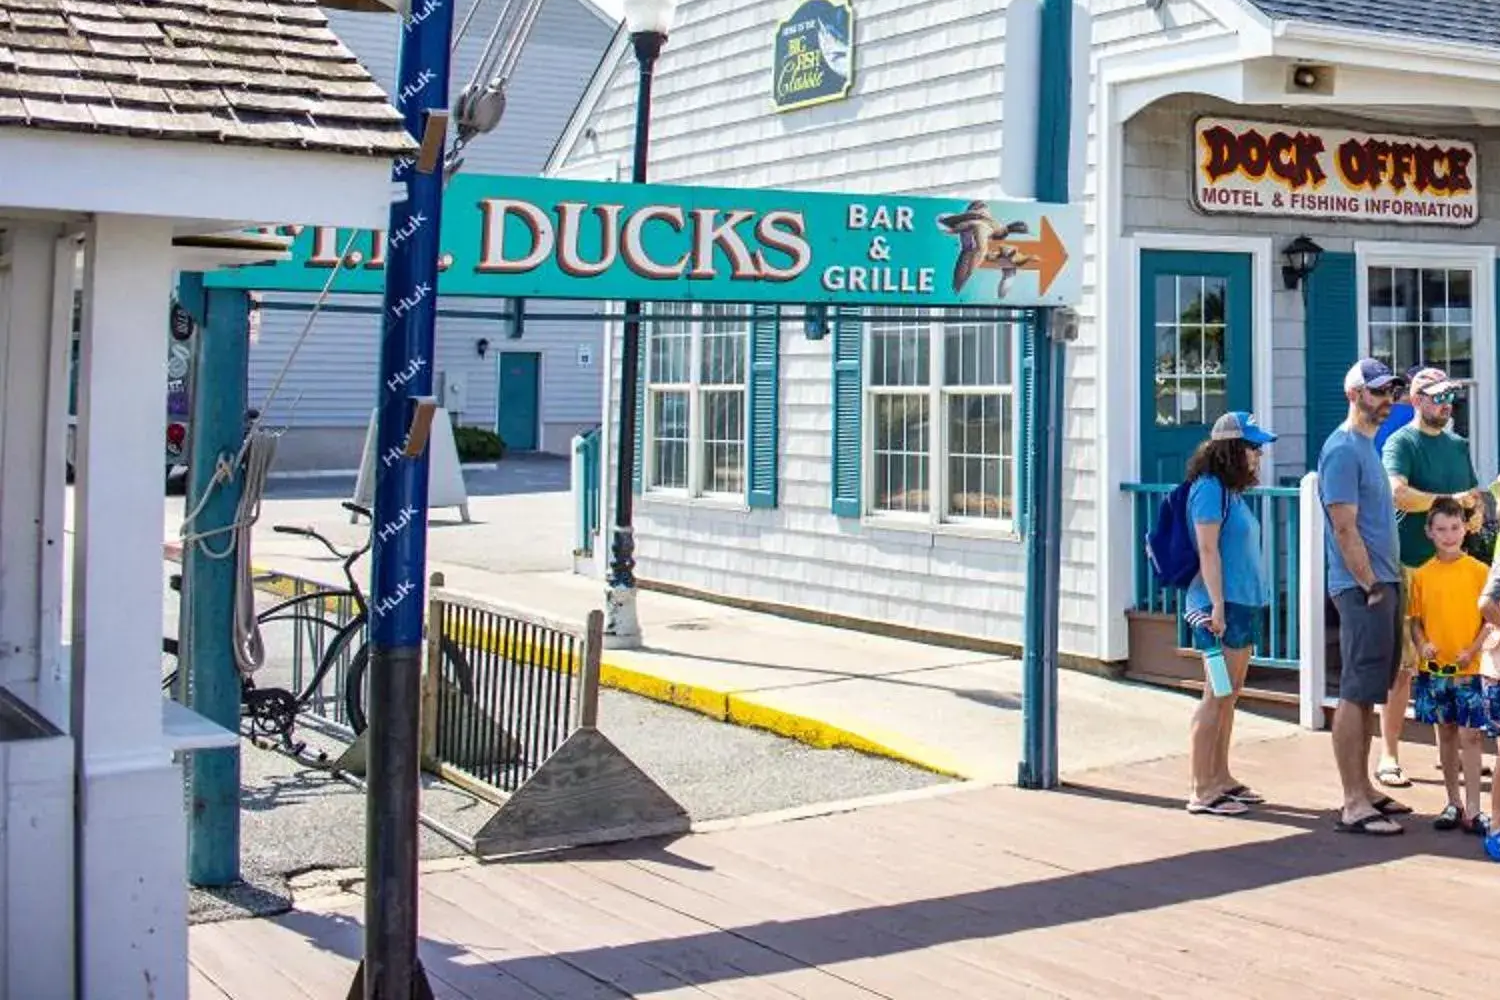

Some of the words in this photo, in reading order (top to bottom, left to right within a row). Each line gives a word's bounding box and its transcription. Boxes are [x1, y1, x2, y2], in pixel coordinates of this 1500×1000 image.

[400, 68, 438, 104] Huk
[1201, 125, 1327, 190] DOCK
[1335, 138, 1473, 197] OFFICE
[847, 203, 915, 233] BAR
[1202, 187, 1263, 207] MOTEL
[1273, 192, 1285, 207] &
[1291, 193, 1359, 212] FISHING
[1365, 198, 1473, 219] INFORMATION
[389, 210, 428, 248] Huk
[476, 199, 813, 281] DUCKS
[868, 235, 891, 261] &
[821, 264, 936, 293] GRILLE
[392, 282, 432, 318] Huk
[387, 355, 427, 392] Huk
[379, 503, 420, 542] Huk
[376, 577, 416, 617] Huk
